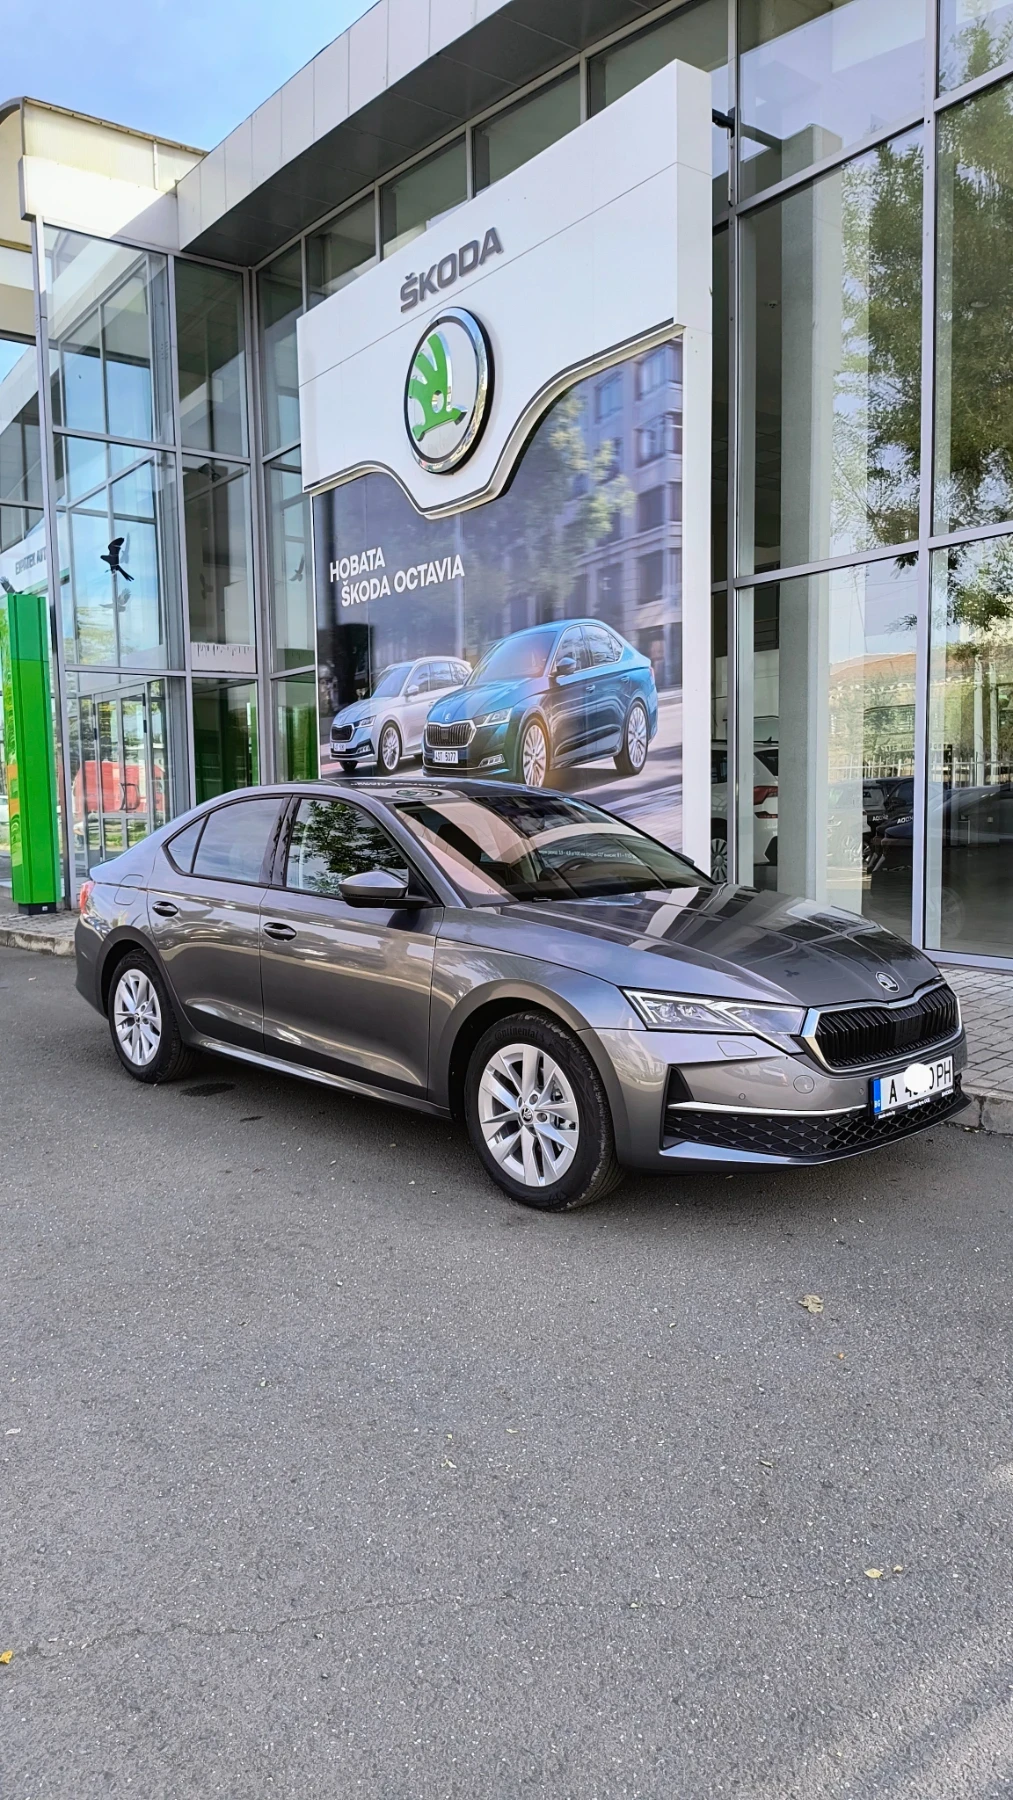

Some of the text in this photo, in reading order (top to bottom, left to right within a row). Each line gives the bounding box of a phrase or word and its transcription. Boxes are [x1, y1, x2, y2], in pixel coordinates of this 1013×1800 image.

[400, 227, 503, 313] ŠKODA
[341, 553, 465, 607] ŠKODA OCTAVIA
[889, 1079, 897, 1105] A
